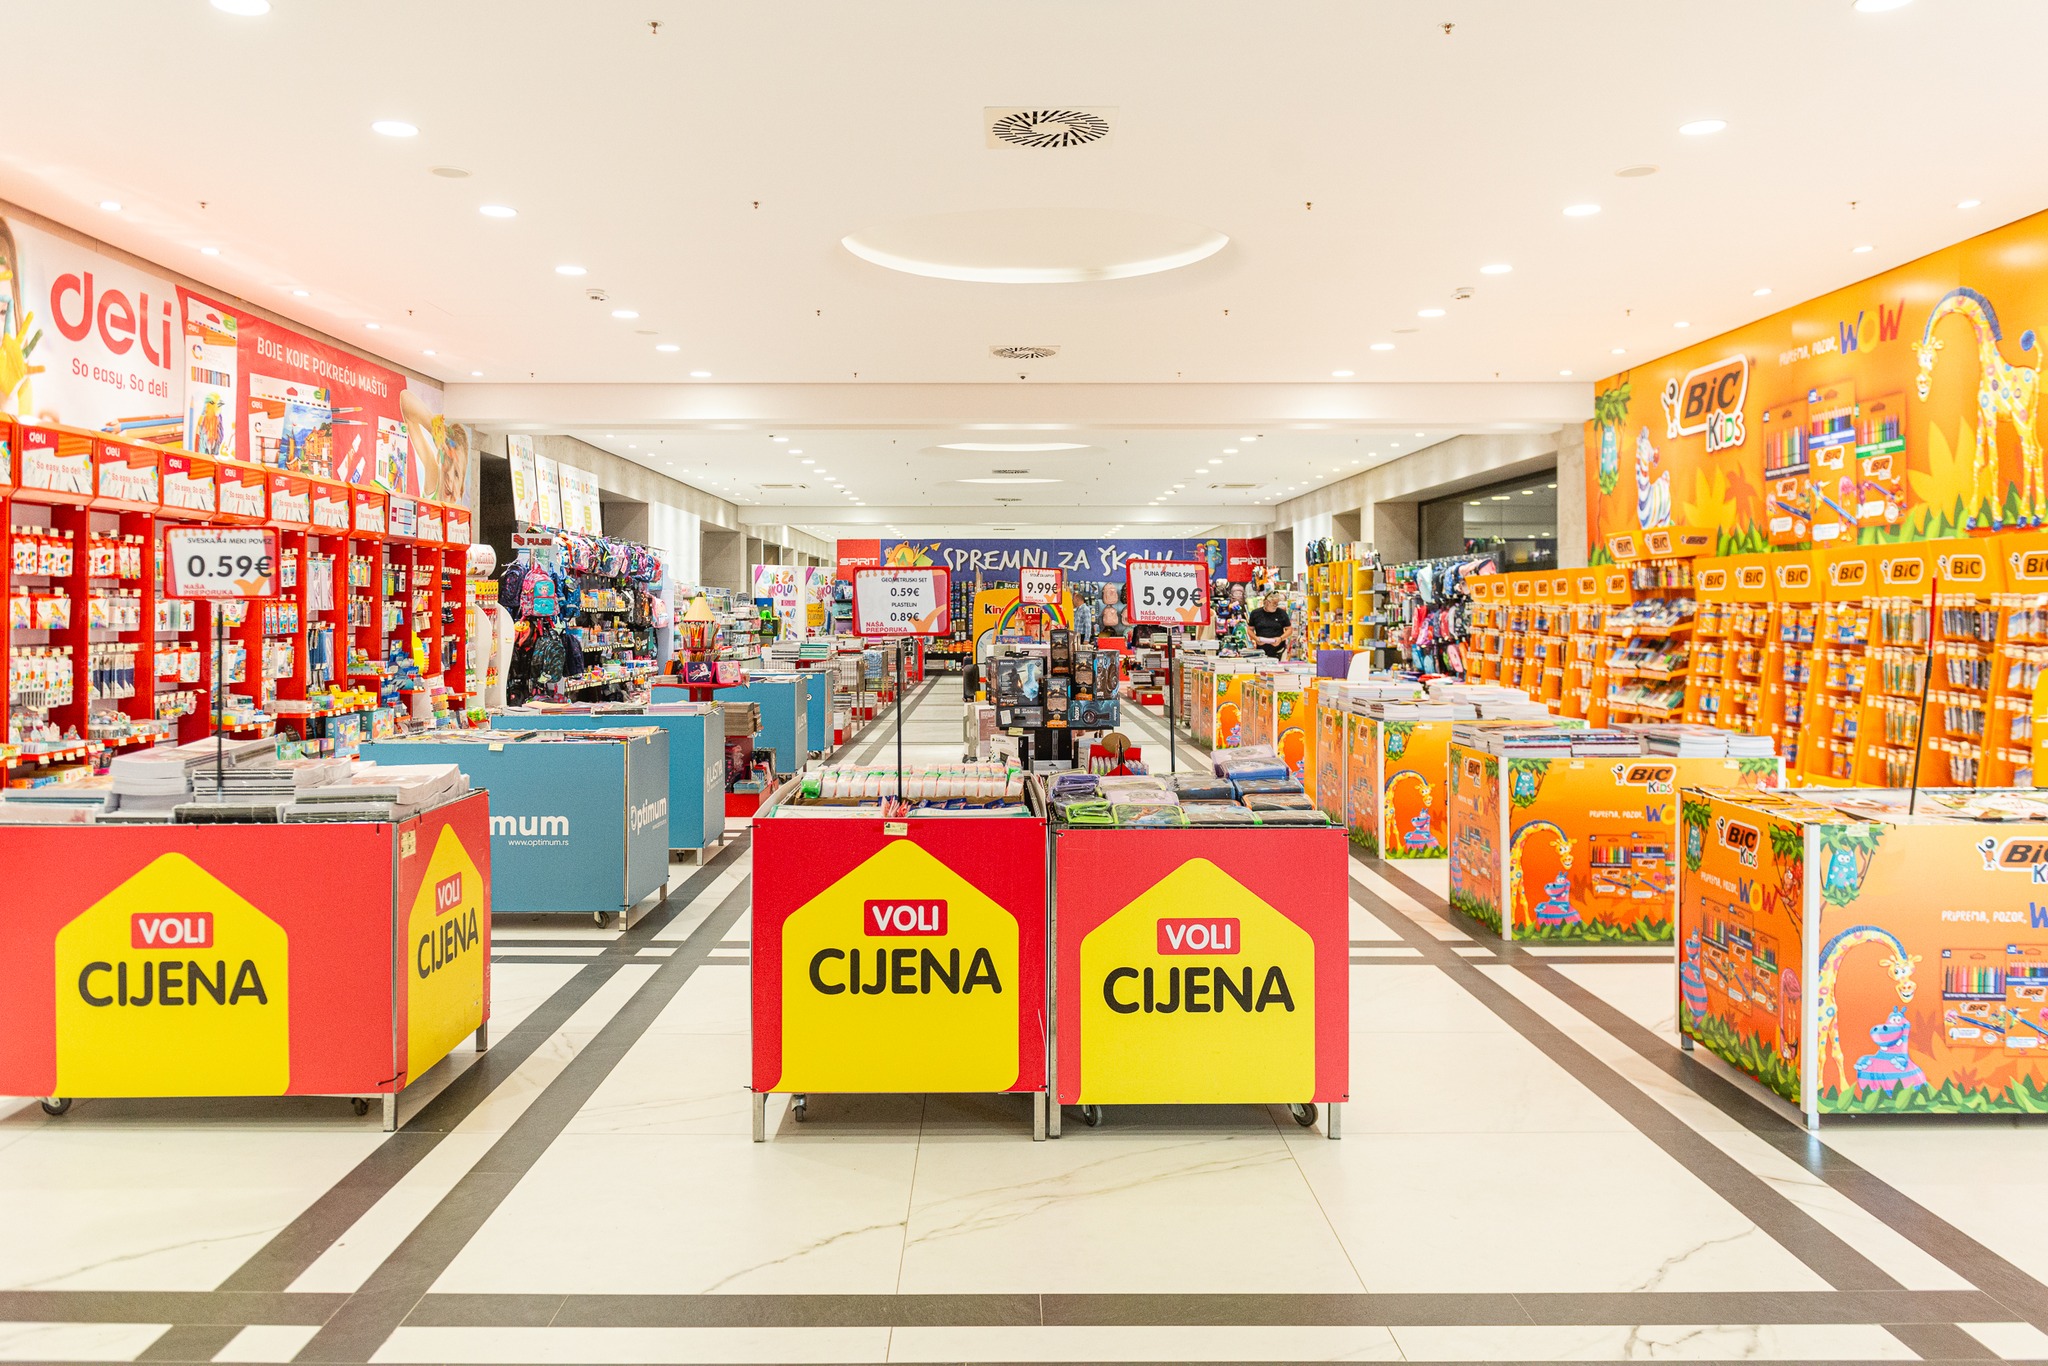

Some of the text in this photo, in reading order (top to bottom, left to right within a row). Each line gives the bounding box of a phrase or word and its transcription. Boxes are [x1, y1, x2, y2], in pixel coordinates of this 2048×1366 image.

[51, 271, 172, 370] deli
[1839, 298, 1905, 355] WOW
[72, 358, 168, 398] So easy, So deli
[257, 336, 387, 398] BOJE KOJE POKREĆU MAŠTU
[29, 432, 46, 445] deli
[105, 446, 120, 458] deli
[169, 458, 183, 469] deli
[224, 467, 236, 478] deli
[187, 554, 273, 578] 0.59€
[839, 557, 879, 566] SPIRIT
[943, 548, 1048, 571] SPREMNI
[1057, 549, 1091, 571] ZA
[1230, 556, 1268, 566] SPIRIT
[890, 587, 920, 597] 0.59€
[1026, 581, 1058, 594] 9.99€
[1143, 586, 1204, 607] 5.99€
[890, 612, 920, 621] 0.89€
[630, 797, 667, 835] Optimum
[1645, 803, 1677, 825] WO
[508, 839, 569, 847] www.optimum.rs
[437, 878, 460, 909] VOLI
[1739, 877, 1779, 915] WOW
[872, 905, 939, 932] VOLI
[1942, 910, 1990, 924] PRIPREMA,
[1992, 911, 2028, 924] POZOR,
[138, 918, 206, 944] VOLI
[417, 907, 479, 979] CIJENA
[1165, 923, 1232, 950] VOLI
[78, 959, 268, 1007] CIJENA
[808, 947, 1003, 995] CIJENA
[1103, 966, 1295, 1014] CIJENA
